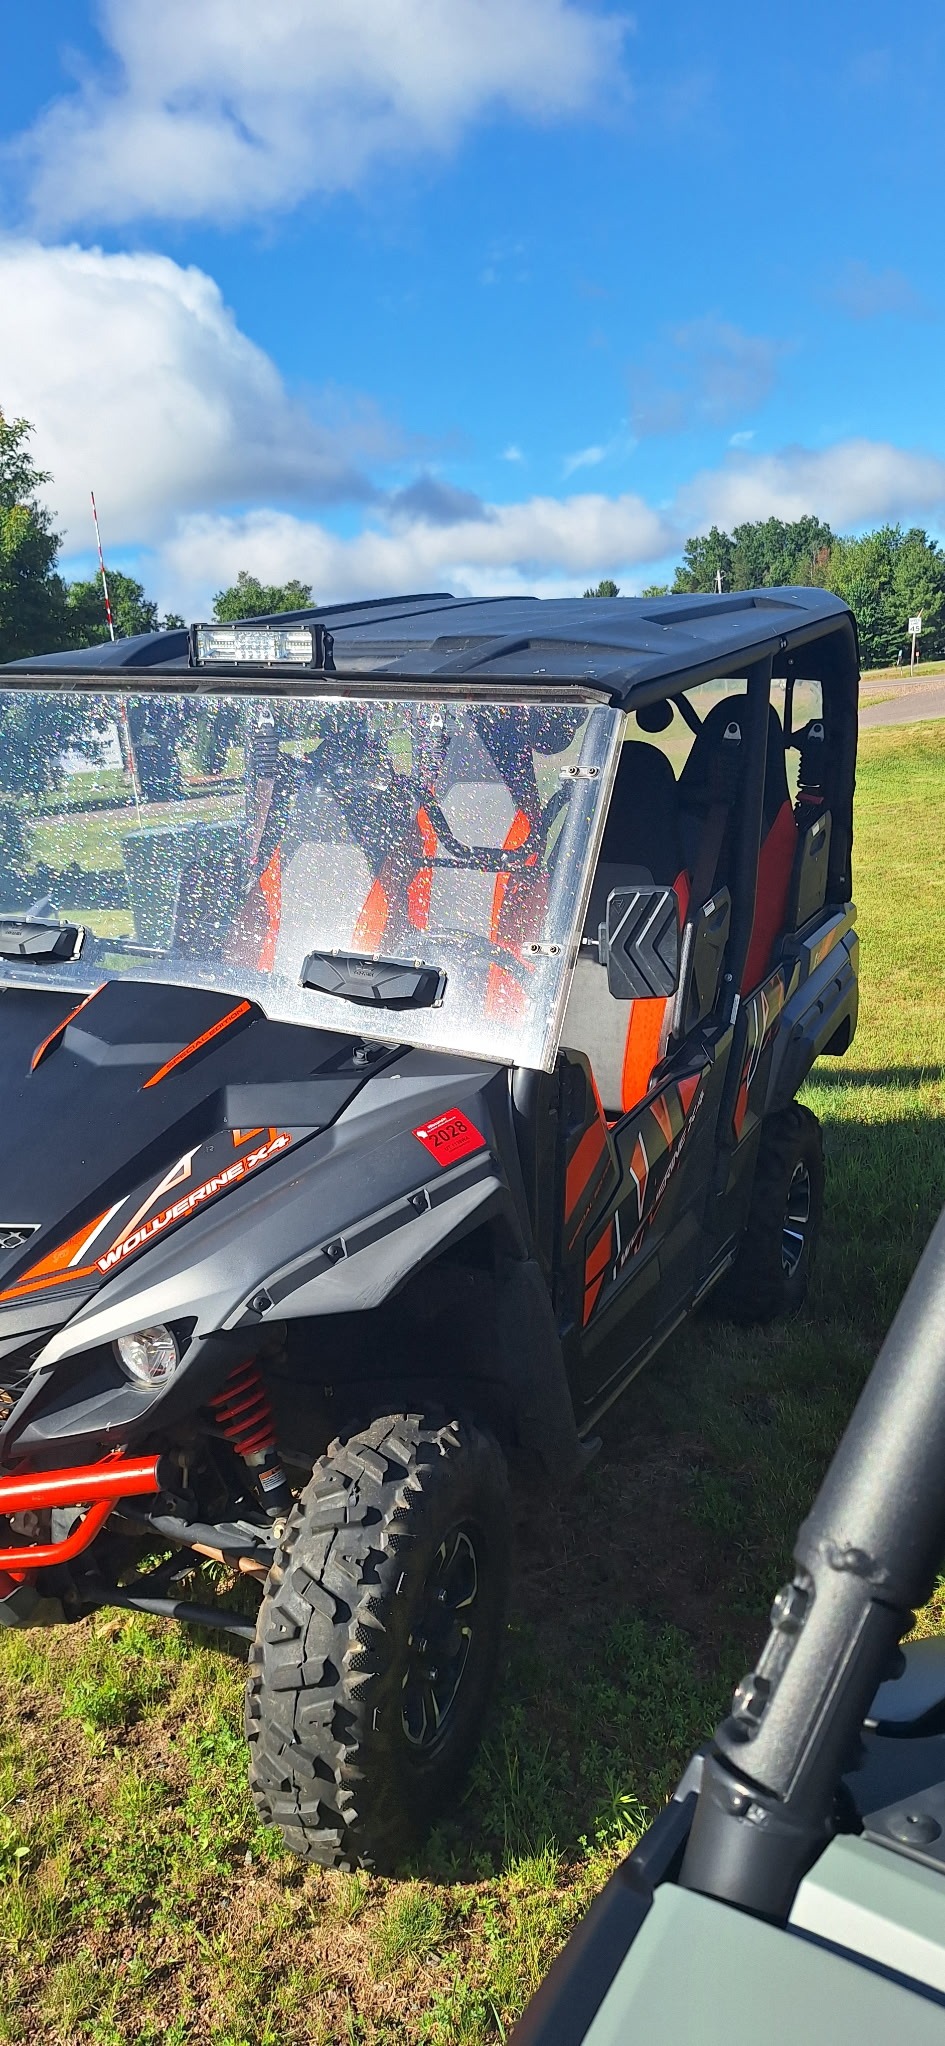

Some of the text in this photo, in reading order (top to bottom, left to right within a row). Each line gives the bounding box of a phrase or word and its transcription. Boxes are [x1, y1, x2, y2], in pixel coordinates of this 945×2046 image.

[166, 1008, 244, 1068] SPECIAL EDITION
[429, 1121, 468, 1147] 2028
[97, 1134, 290, 1271] WOLVERINE X4
